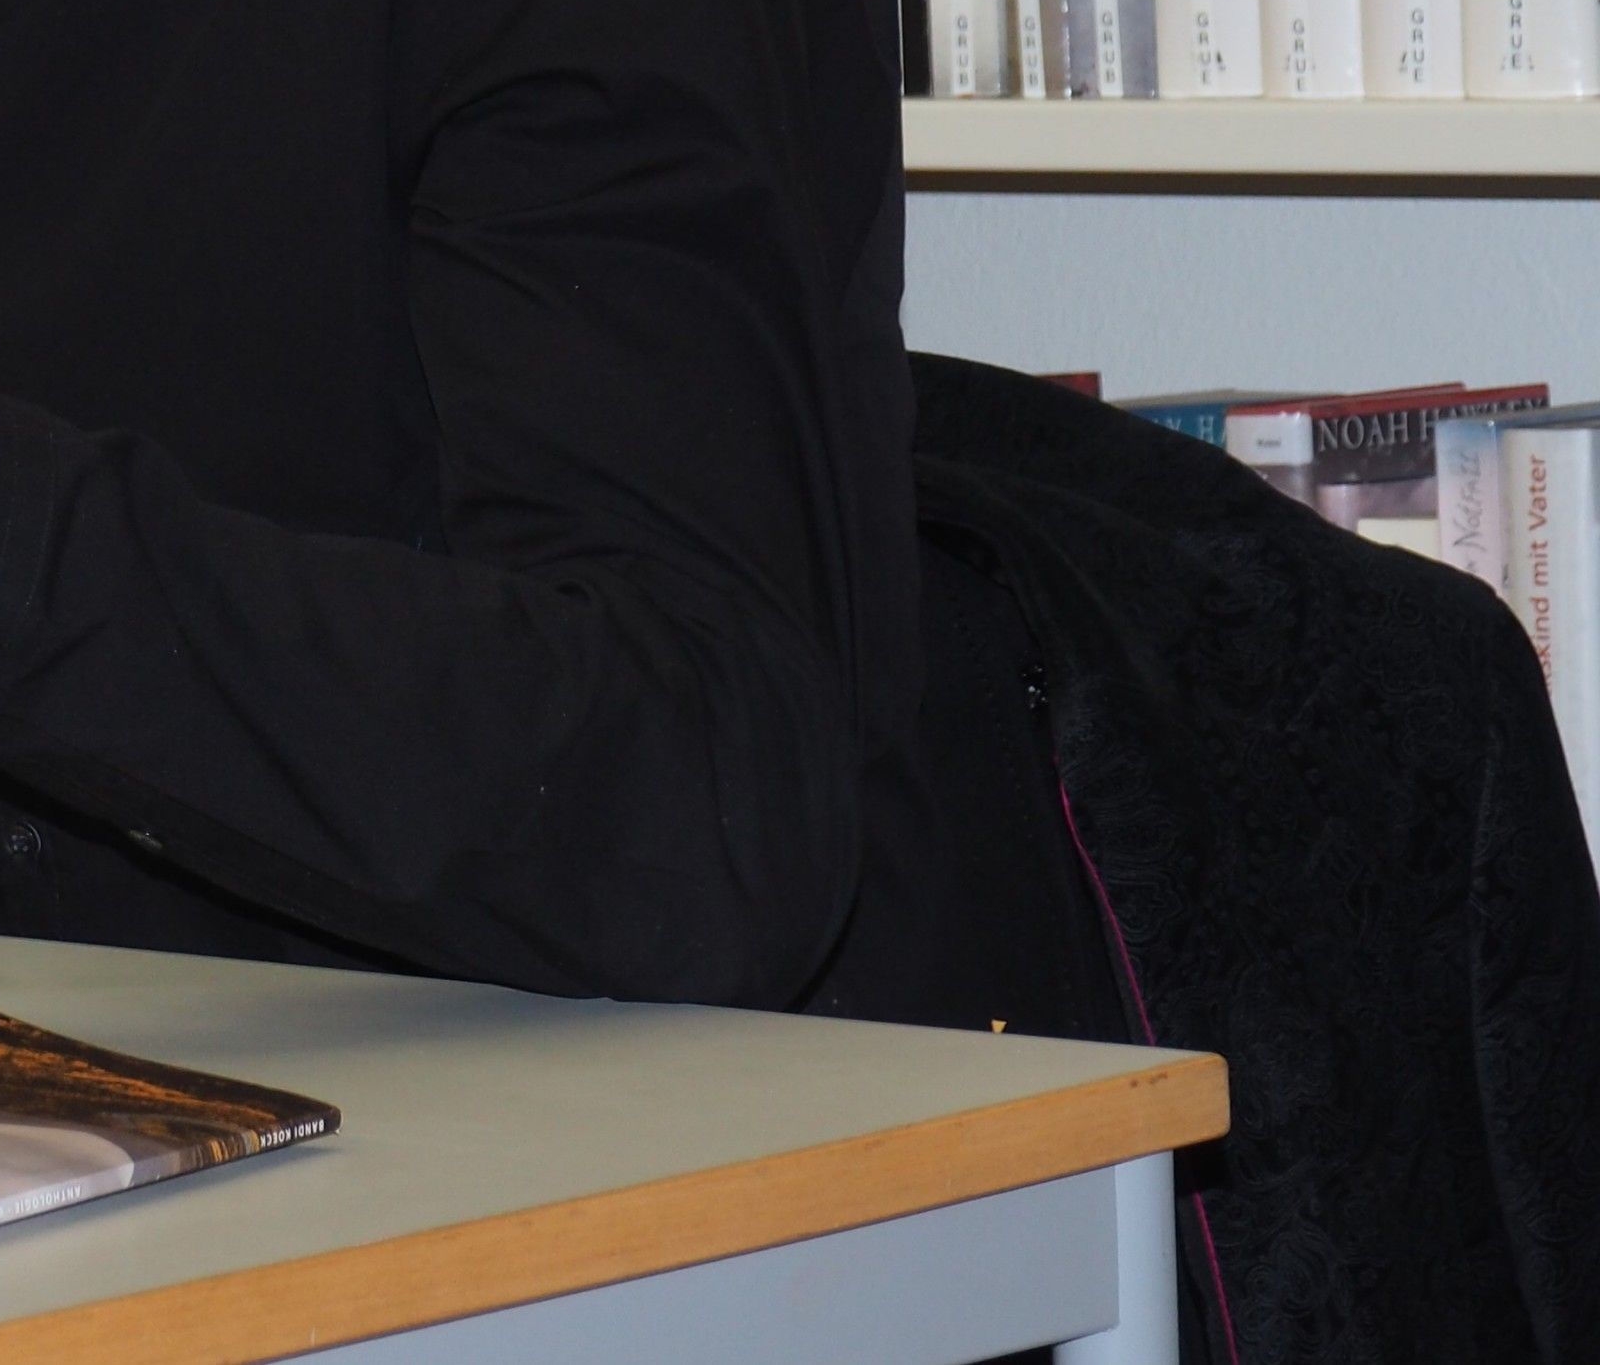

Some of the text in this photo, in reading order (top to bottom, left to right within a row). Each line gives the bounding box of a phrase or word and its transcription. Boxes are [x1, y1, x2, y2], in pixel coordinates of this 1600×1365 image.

[1197, 12, 1213, 86] GRUE
[1293, 18, 1308, 92] GRUE
[1411, 8, 1426, 84] GRUE
[1316, 413, 1410, 453] NOAH
[1527, 454, 1550, 587] mit Vater
[259, 1119, 326, 1149] BANDI KOECK
[14, 1182, 83, 1217] ANTHOLOGIE
